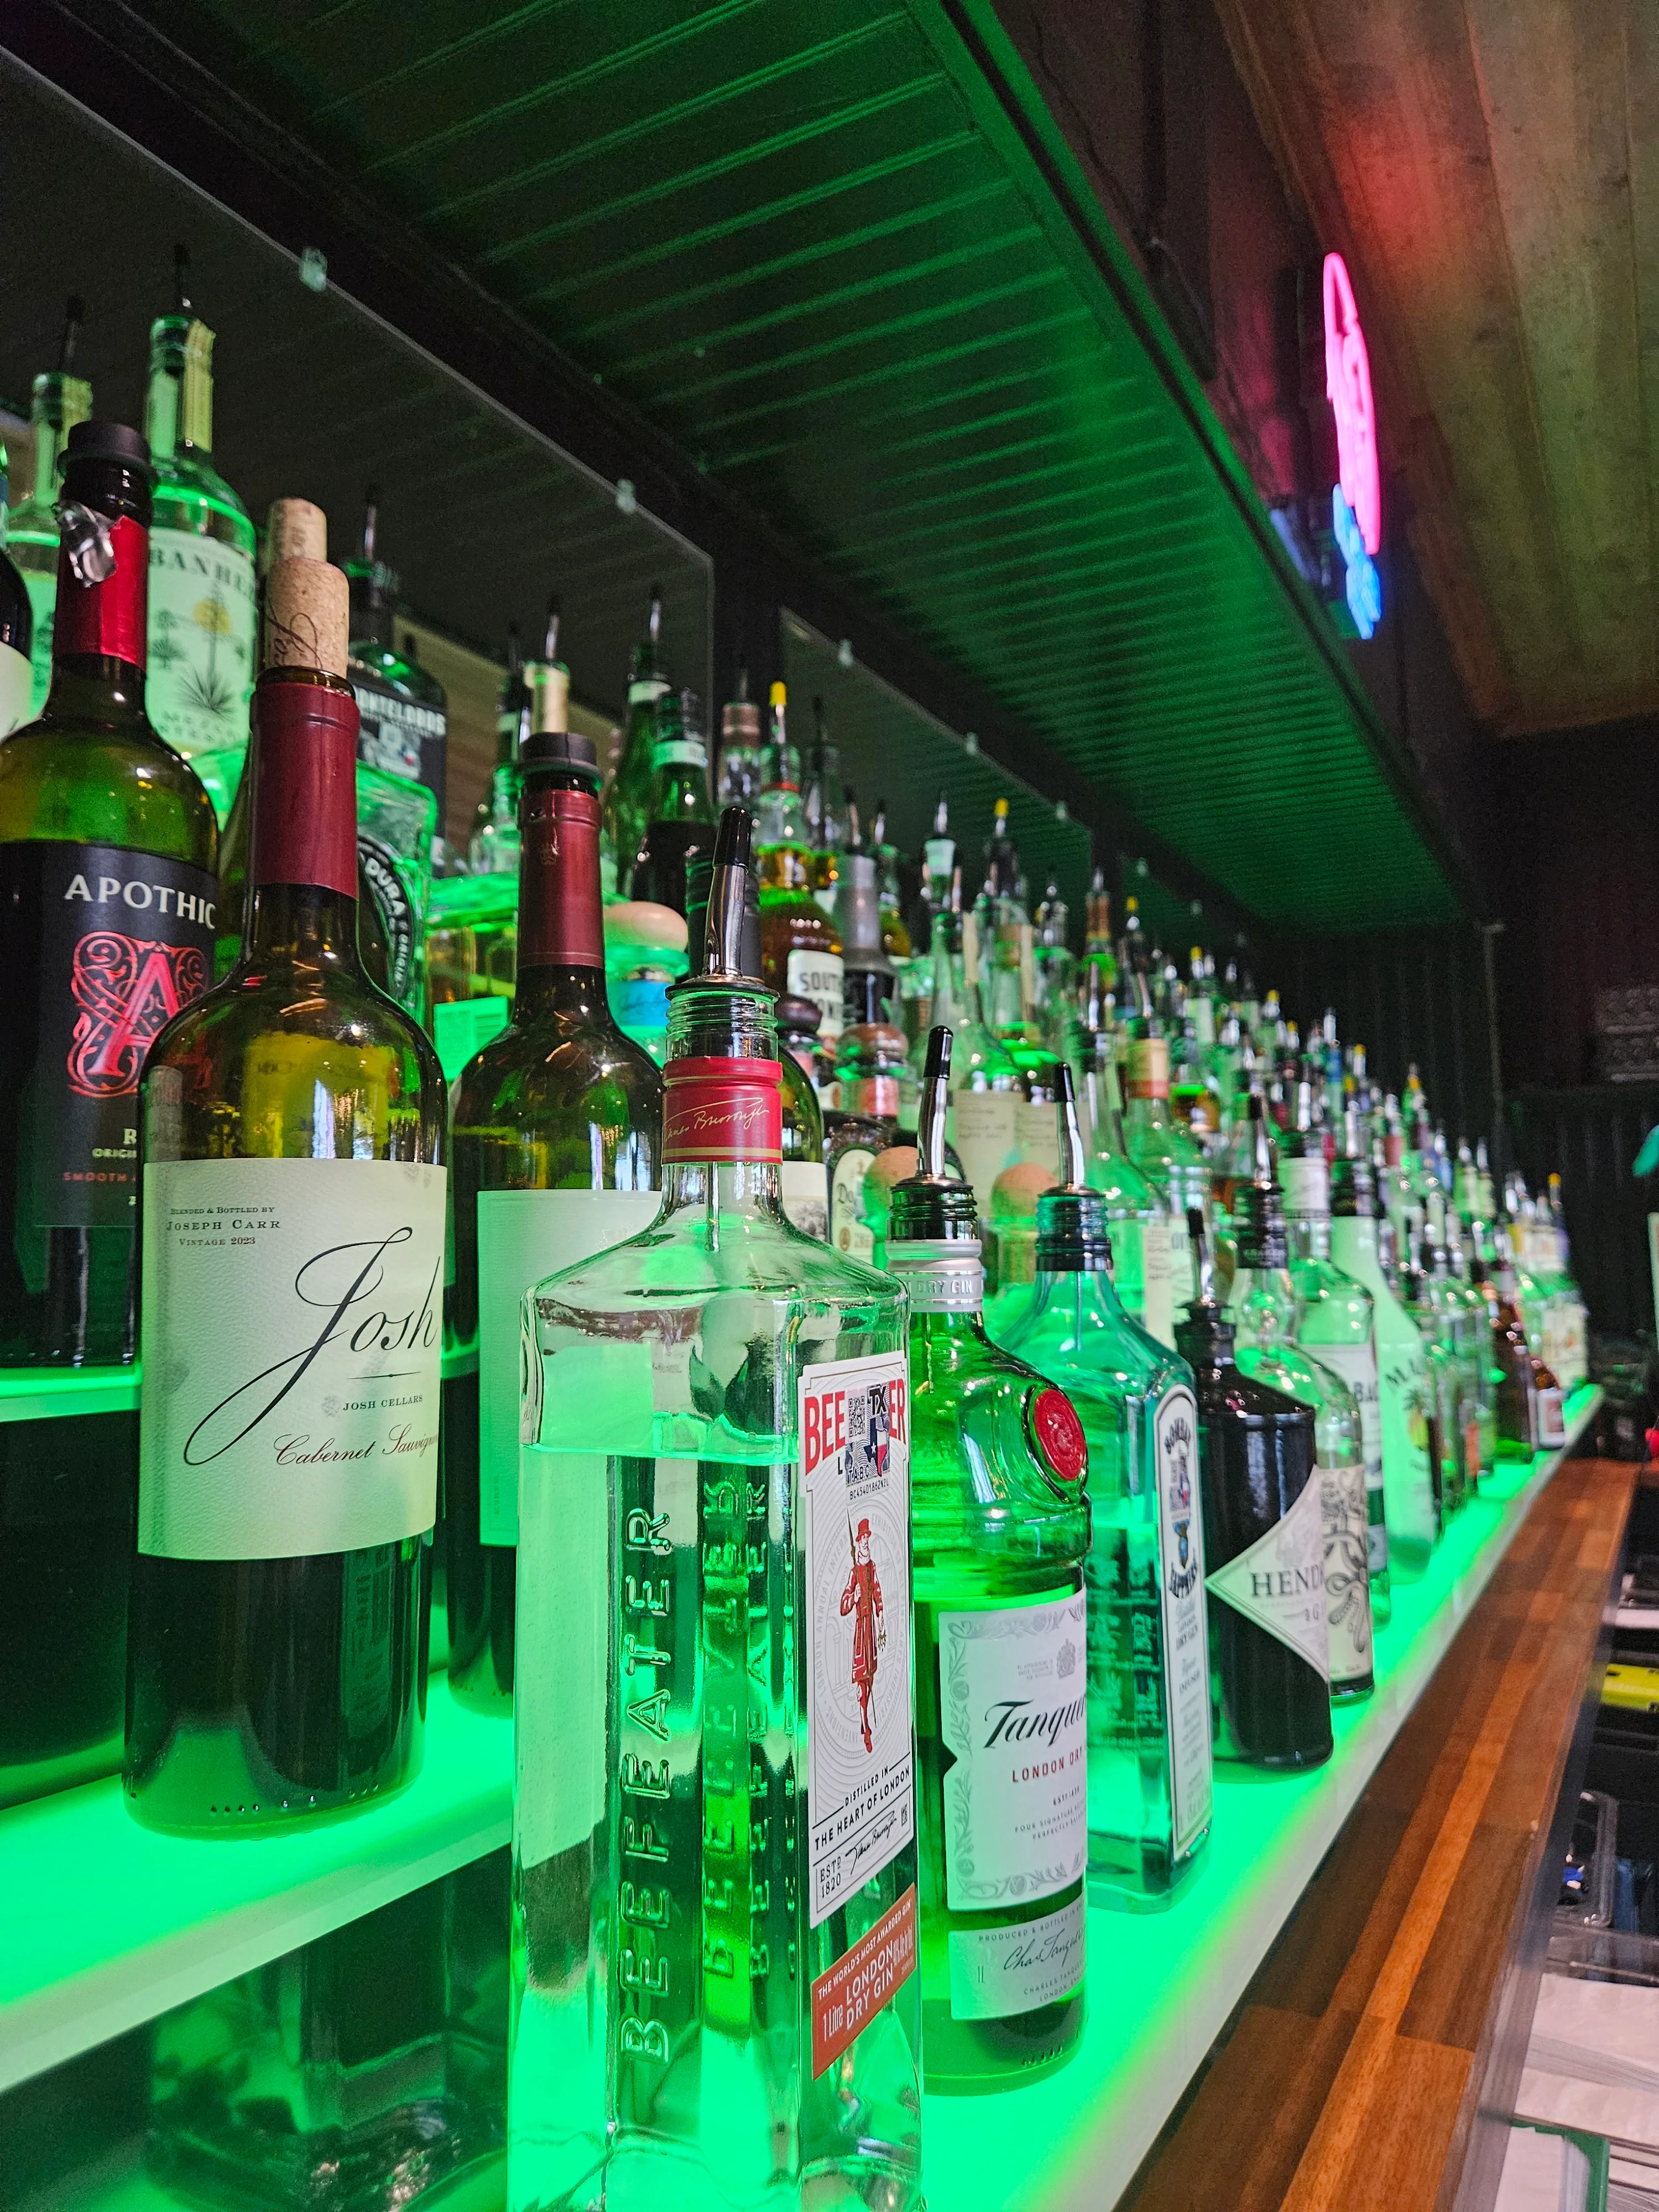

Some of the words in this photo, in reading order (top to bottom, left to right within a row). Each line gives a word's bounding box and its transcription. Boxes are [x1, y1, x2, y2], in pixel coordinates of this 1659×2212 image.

[64, 873, 216, 930] APOTHIC
[166, 1221, 222, 1231] JOSEPH
[232, 1219, 281, 1229] CARR
[231, 1237, 256, 1245] 2023
[951, 1280, 973, 1294] GIN
[184, 1226, 441, 1465] Josh
[342, 1400, 376, 1411] JOSH
[381, 1395, 424, 1408] CELLARS
[869, 1386, 887, 1415] TX
[805, 1378, 907, 1476] BEEER
[273, 1433, 377, 1465] Cabernet
[382, 1423, 439, 1458] Sauvign
[620, 1506, 672, 2064] BEEFEATER
[845, 1773, 879, 1807] DISTILLED
[881, 1765, 888, 1778] IN
[1013, 1756, 1065, 1783] LONDON
[815, 1827, 833, 1851] THE
[837, 1803, 864, 1836] HEART
[867, 1793, 877, 1811] OF
[880, 1765, 909, 1801] LONDON
[1015, 1822, 1036, 1833] FOUR
[821, 1872, 841, 1899] 1820
[979, 1929, 1028, 1942] PRODUCED
[1040, 1913, 1068, 1931] BOTTLED
[818, 1980, 832, 2001] THE
[833, 1953, 860, 1987] WORLD'S
[861, 1936, 877, 1960] MOST
[877, 1911, 901, 1944] AWARDED
[902, 1899, 911, 1917] GIN
[846, 1939, 893, 2006] LONDON
[1024, 1978, 1058, 1995] CHARLES
[847, 1987, 870, 2031] DRY
[873, 1963, 894, 1999] GIN
[1040, 1985, 1067, 2002] LONDON
[823, 2012, 827, 2042] 1
[828, 2004, 843, 2038] Litre
